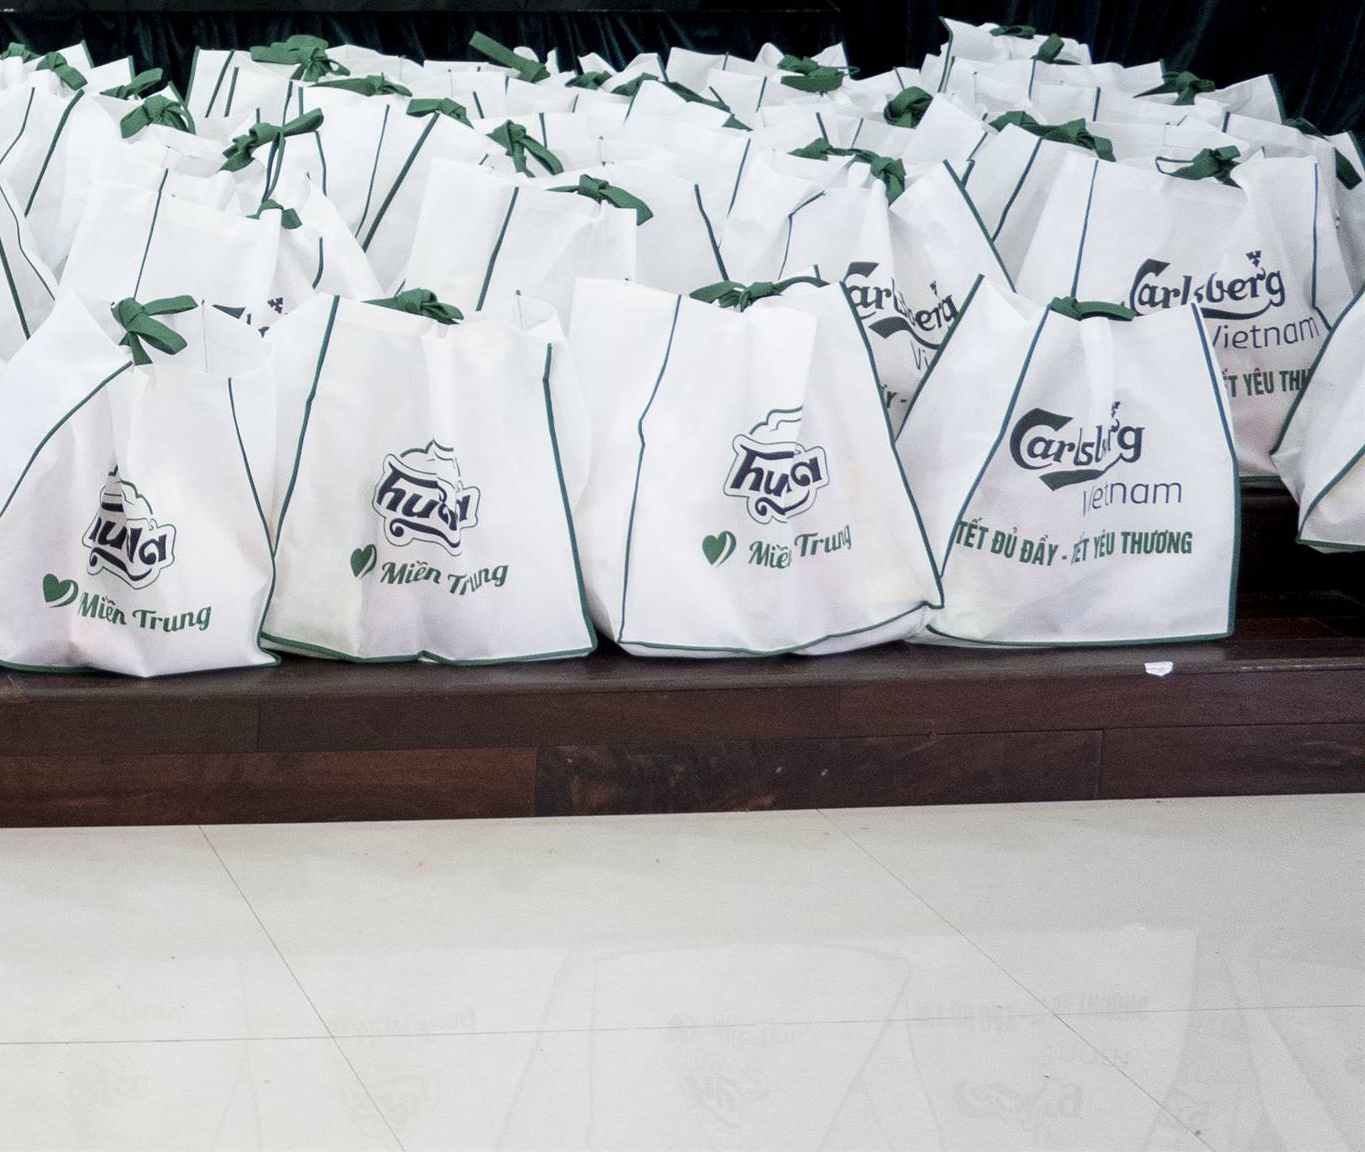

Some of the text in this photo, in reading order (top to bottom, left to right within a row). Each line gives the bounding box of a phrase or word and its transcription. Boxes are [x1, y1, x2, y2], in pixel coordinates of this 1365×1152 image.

[1243, 368, 1275, 396] YÊU
[730, 443, 823, 516] hua
[794, 524, 852, 558] Trung
[955, 517, 989, 551] TẾT
[990, 526, 1018, 559] ĐỦ
[1019, 535, 1059, 567] ĐẦY
[1093, 528, 1116, 559] YÊU
[1121, 529, 1194, 554] THƯƠNG
[380, 560, 509, 596] Miền Trung
[77, 591, 212, 633] Miền Trung
